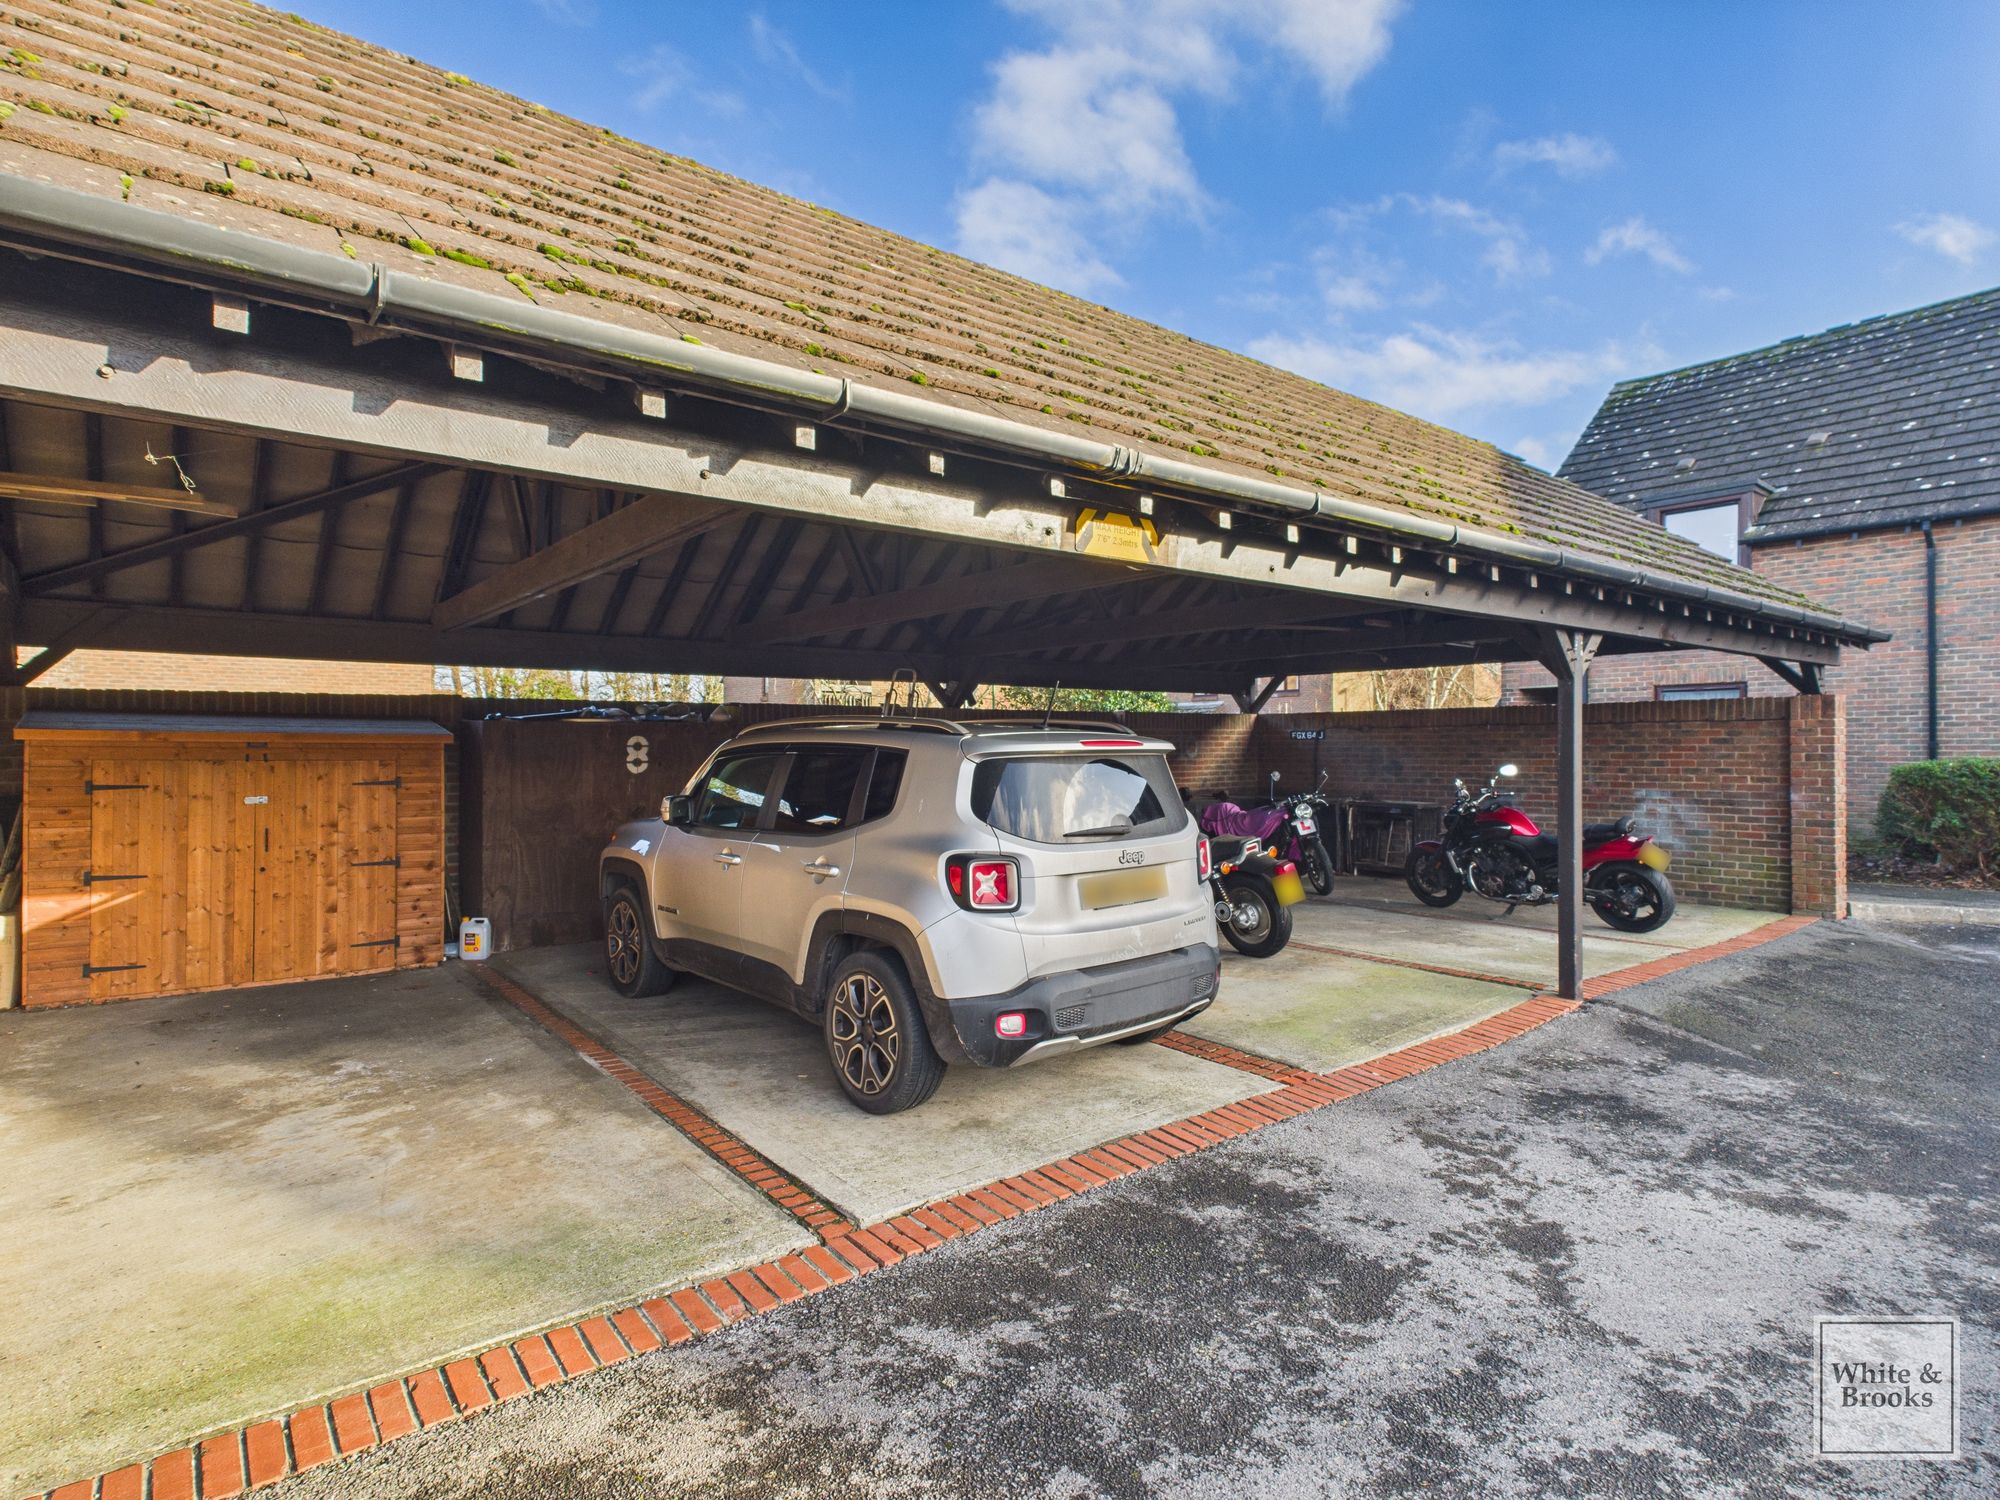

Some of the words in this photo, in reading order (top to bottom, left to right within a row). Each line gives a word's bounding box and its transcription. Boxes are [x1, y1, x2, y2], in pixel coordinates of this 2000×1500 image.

[1096, 522, 1111, 532] MAX
[1113, 525, 1140, 536] HEIGHT
[626, 735, 649, 774] 8
[1300, 821, 1311, 831] L
[1118, 850, 1146, 865] Jeep
